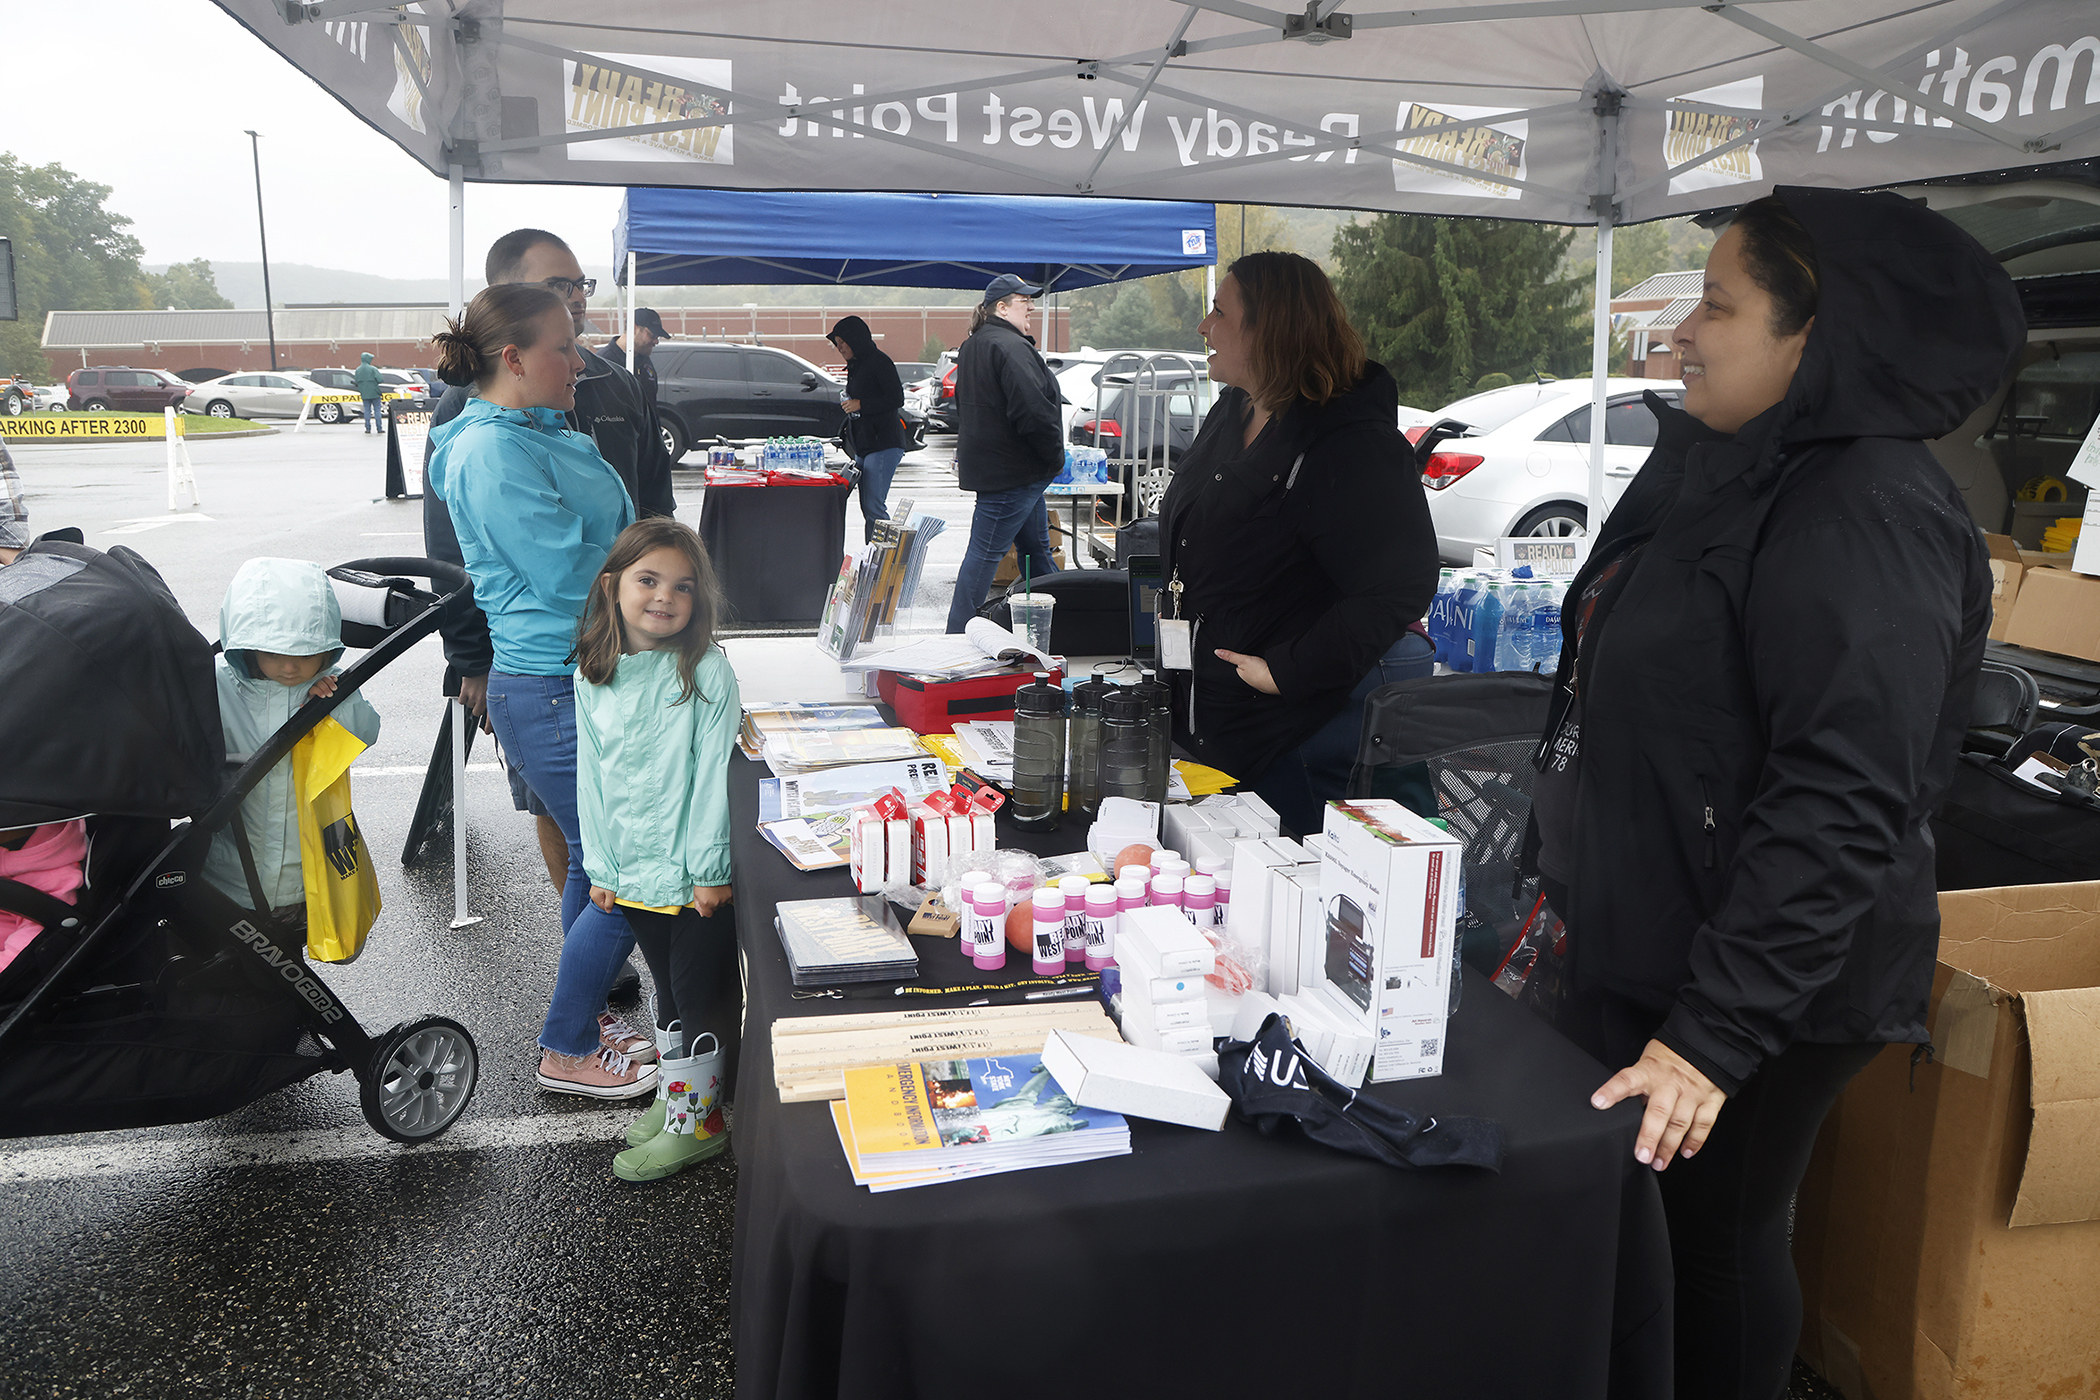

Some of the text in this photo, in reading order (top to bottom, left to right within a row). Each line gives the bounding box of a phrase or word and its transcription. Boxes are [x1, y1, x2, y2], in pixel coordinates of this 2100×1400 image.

[345, 394, 393, 402] PARG
[406, 412, 433, 424] READ
[60, 420, 109, 434] AFTER
[114, 420, 146, 434] 2300
[1528, 544, 1564, 560] READY
[1546, 559, 1574, 572] POINT
[1428, 596, 1474, 630] ASNI
[1552, 754, 1568, 772] 78
[158, 875, 184, 886] chicco
[1038, 943, 1062, 958] WEST
[936, 1043, 958, 1051] WEST
[989, 1076, 999, 1092] STATE
[996, 1076, 1005, 1090] YORK
[1004, 1074, 1012, 1088] NEW
[886, 1065, 910, 1147] ANDBOOK
[904, 1104, 930, 1146] INFORMATION
